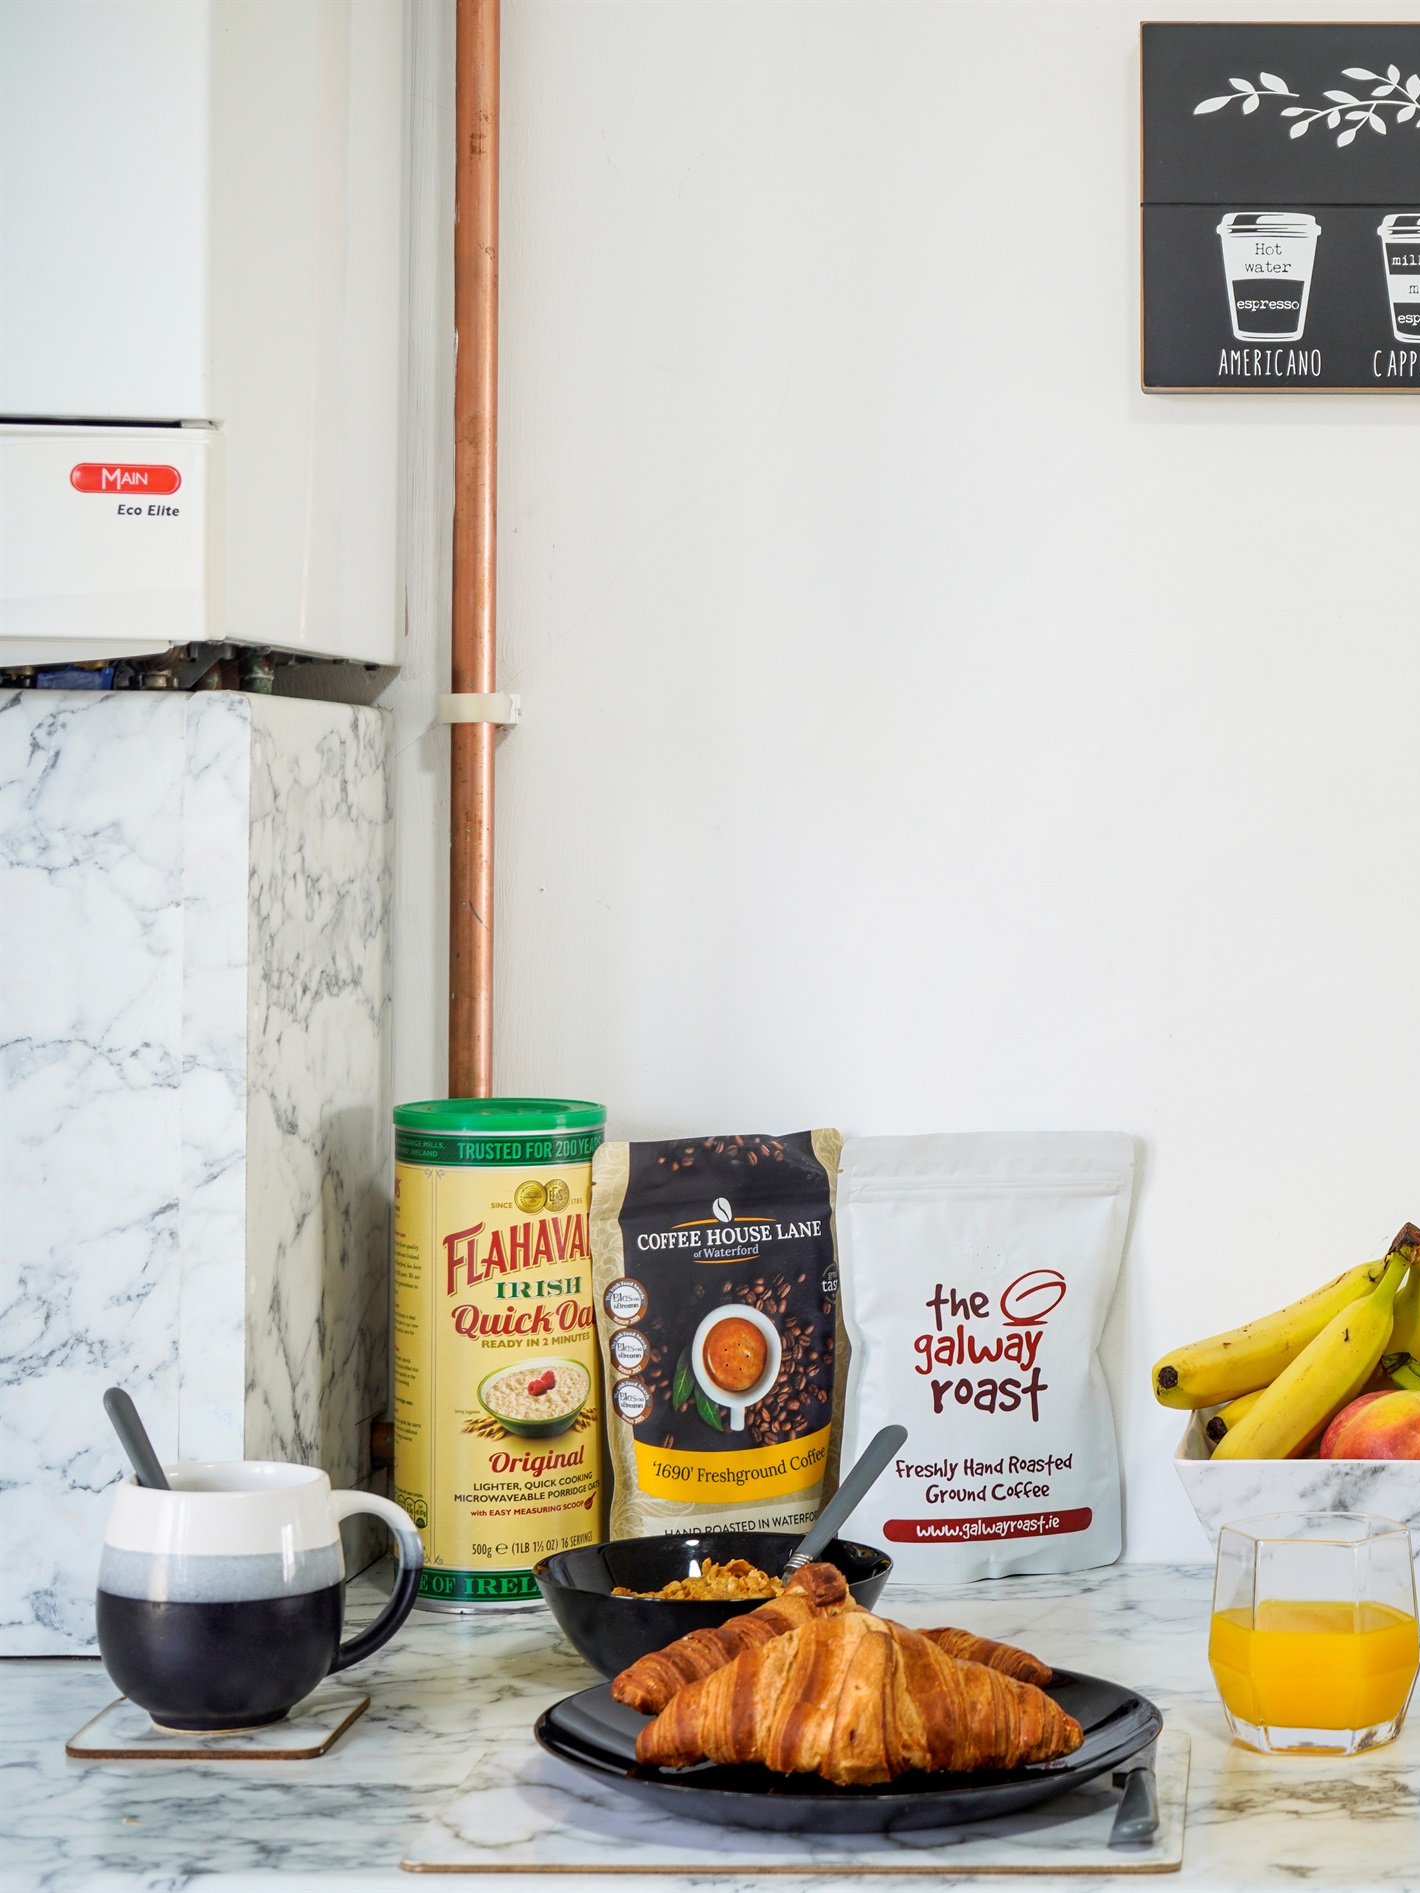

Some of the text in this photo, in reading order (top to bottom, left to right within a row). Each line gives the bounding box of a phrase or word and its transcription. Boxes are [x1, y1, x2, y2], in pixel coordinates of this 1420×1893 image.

[1256, 243, 1282, 255] Hot
[1246, 262, 1291, 273] water
[1237, 300, 1299, 311] espresso
[1219, 349, 1321, 376] AMERICANO
[117, 504, 179, 516] Eco Elite
[458, 1142, 521, 1159] TRUSTED
[526, 1142, 551, 1159] FOR
[556, 1141, 577, 1157] 200
[637, 1220, 822, 1250] COFFEE HOUSE LANE
[703, 1244, 759, 1258] Waterford
[496, 1276, 582, 1299] IRISH
[926, 1283, 989, 1331] the
[451, 1300, 596, 1339] Quick Oa
[482, 1332, 590, 1348] READY IN 2 MINUTES
[914, 1324, 1043, 1375] galway
[931, 1367, 1048, 1422] roast
[489, 1445, 585, 1477] Original
[698, 1460, 787, 1486] Freshground
[790, 1446, 826, 1471] Coffee
[895, 1453, 1073, 1482] Freshly Hand Roasted
[474, 1471, 592, 1491] LIGHTER, QUICK COOKING
[925, 1481, 1050, 1504] Ground Coffee
[455, 1492, 545, 1502] MICROWAVEABLE
[548, 1485, 587, 1499] PORRIDGE
[514, 1504, 561, 1515] MEASURING
[563, 1500, 584, 1510] SCOOP
[705, 1520, 756, 1534] ROASTED
[758, 1518, 770, 1529] IN
[772, 1511, 818, 1527] WATERFO
[916, 1515, 1060, 1539] www.galwayroast.ie
[472, 1543, 492, 1558] 500g
[512, 1542, 530, 1555] (1LB
[546, 1539, 558, 1551] OZ)
[562, 1537, 568, 1548] 16
[570, 1531, 592, 1547] SERVINGS
[433, 1576, 456, 1593] OF
[464, 1577, 540, 1595] IREL
